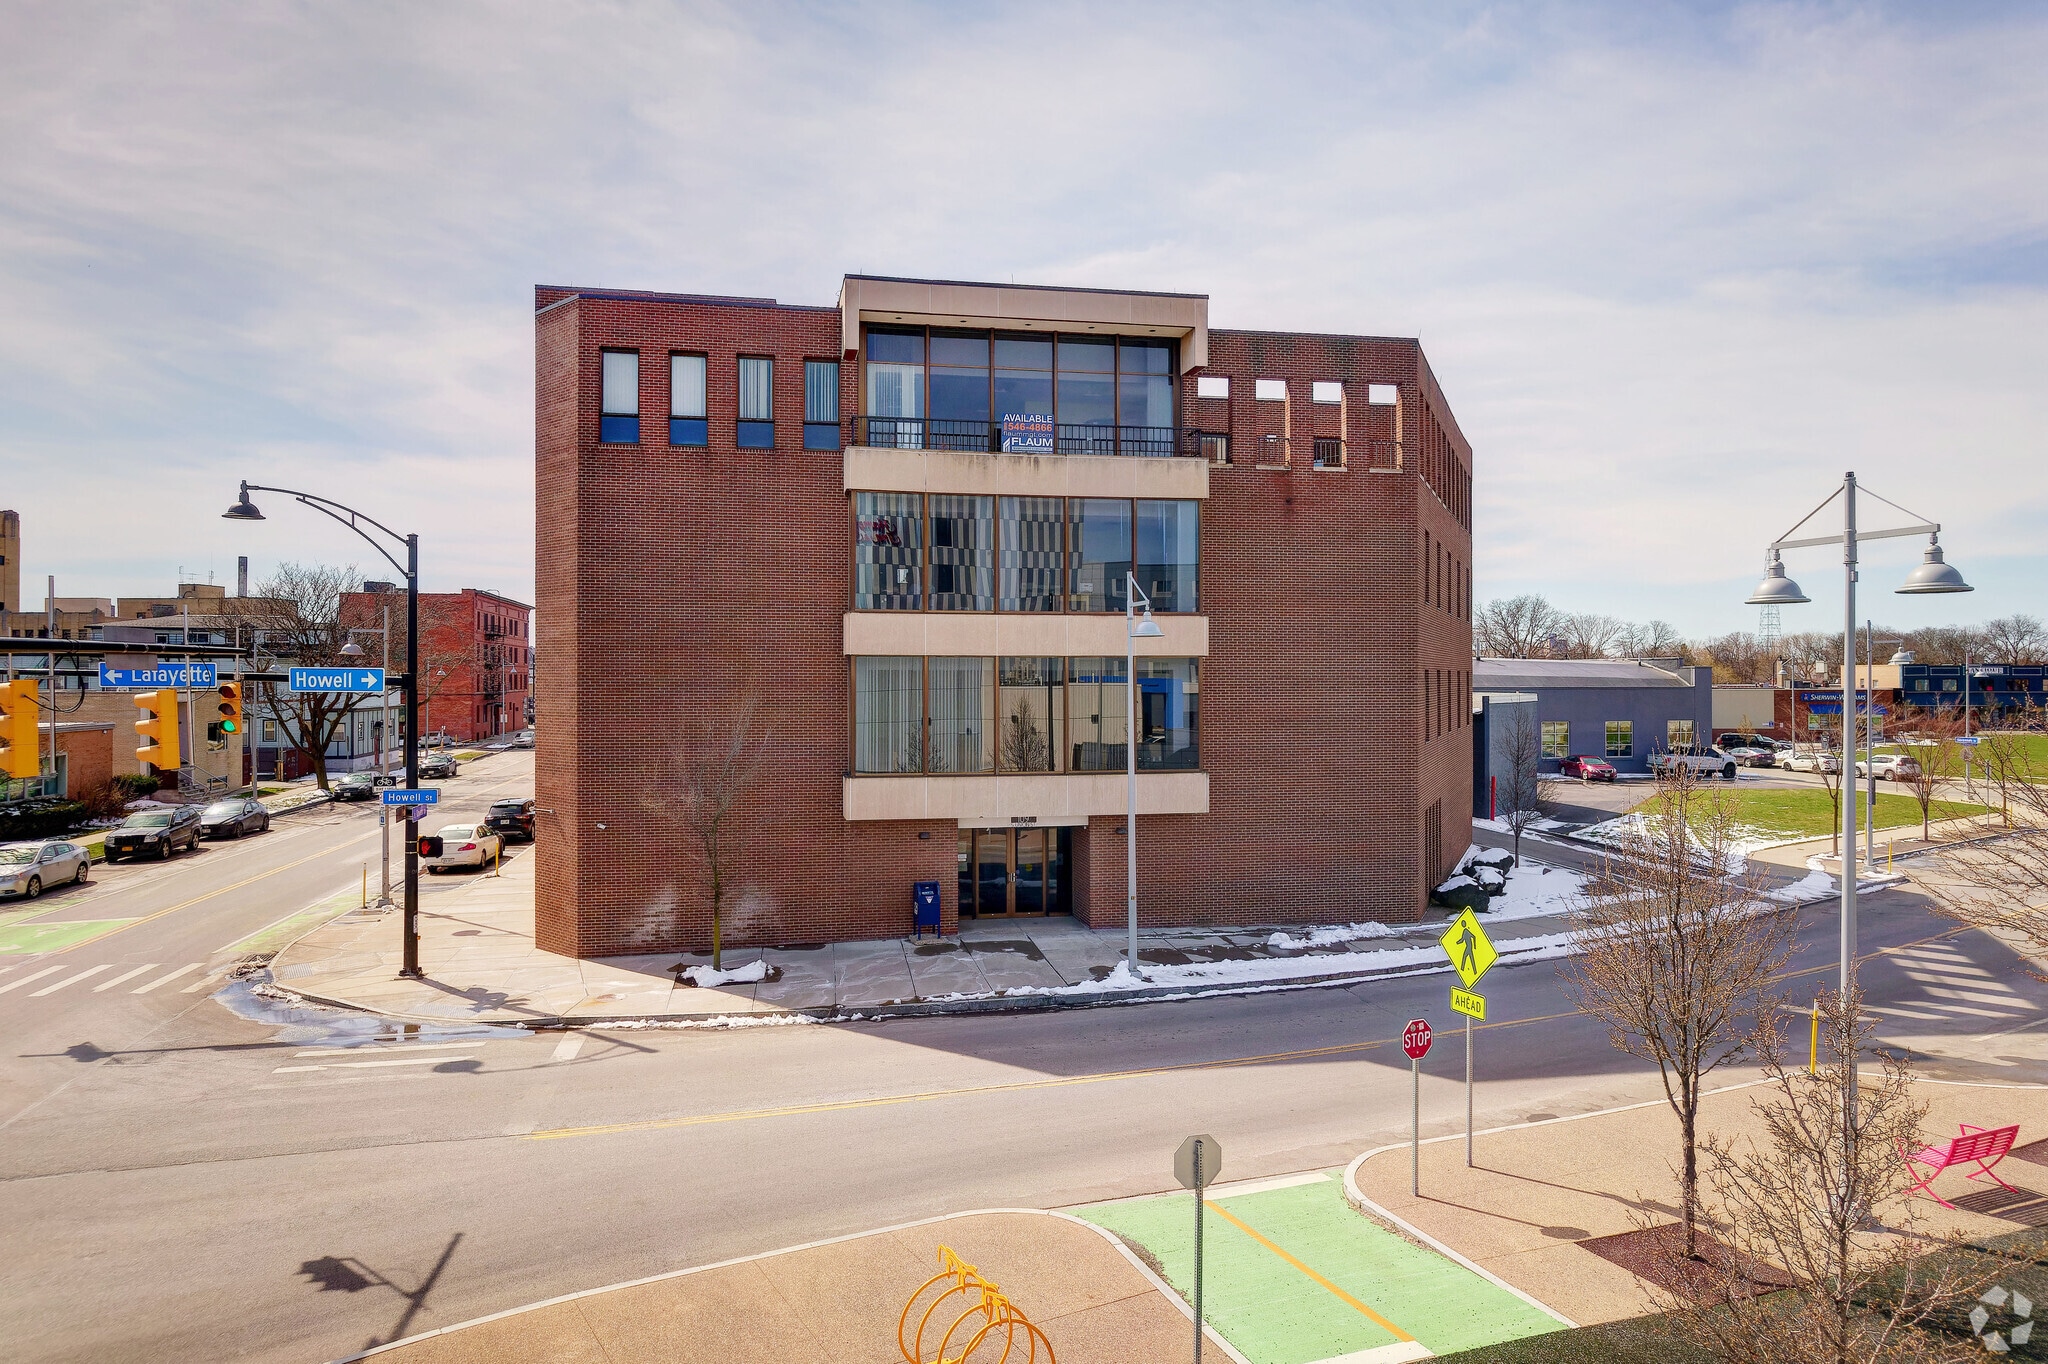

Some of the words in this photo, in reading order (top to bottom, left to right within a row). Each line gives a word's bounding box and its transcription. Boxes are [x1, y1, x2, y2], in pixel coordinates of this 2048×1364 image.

[1003, 413, 1053, 423] AVAILABLE
[1011, 437, 1053, 447] FLAUM
[131, 666, 212, 686] Lafayette
[295, 671, 352, 688] Howell
[388, 793, 421, 802] Howell
[1455, 995, 1481, 1013] AHEAD
[1404, 1031, 1431, 1049] STOP
